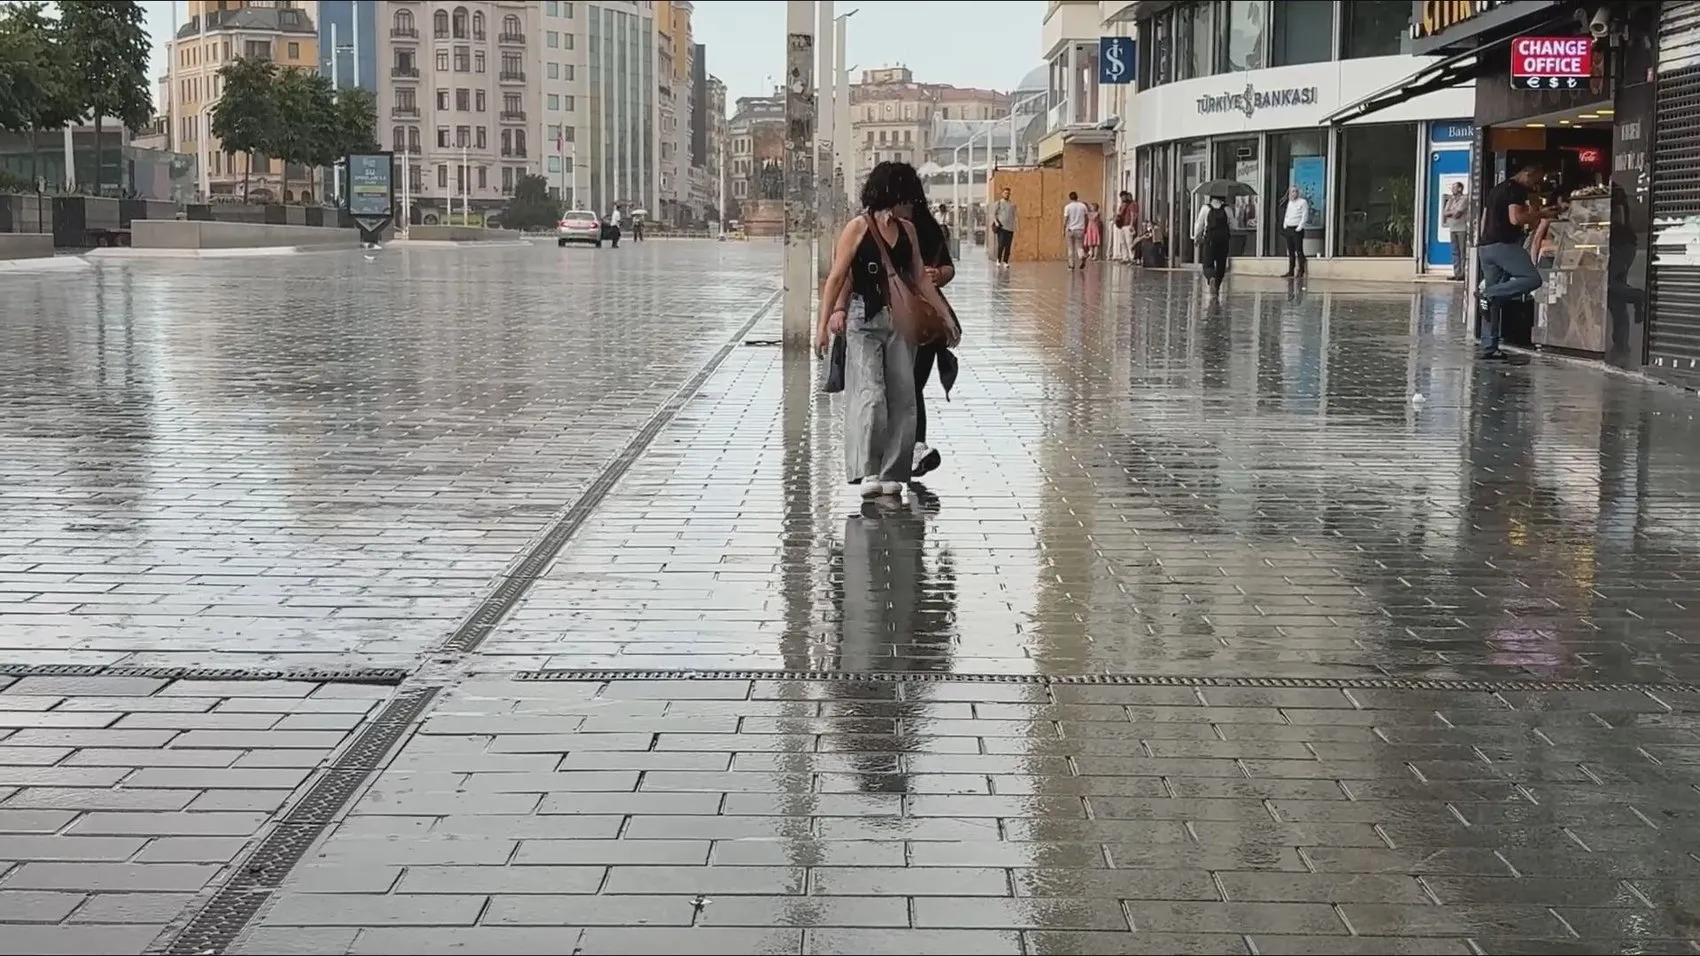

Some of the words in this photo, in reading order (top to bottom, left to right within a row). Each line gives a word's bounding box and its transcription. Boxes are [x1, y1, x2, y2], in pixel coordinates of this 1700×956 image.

[1519, 40, 1587, 55] CHANGE
[1523, 58, 1581, 72] OFFICE
[1527, 77, 1540, 88] €
[1549, 77, 1559, 88] $
[1196, 91, 1244, 115] TÜRKİYE
[1254, 86, 1318, 109] BANKASI
[1449, 125, 1474, 138] Bank
